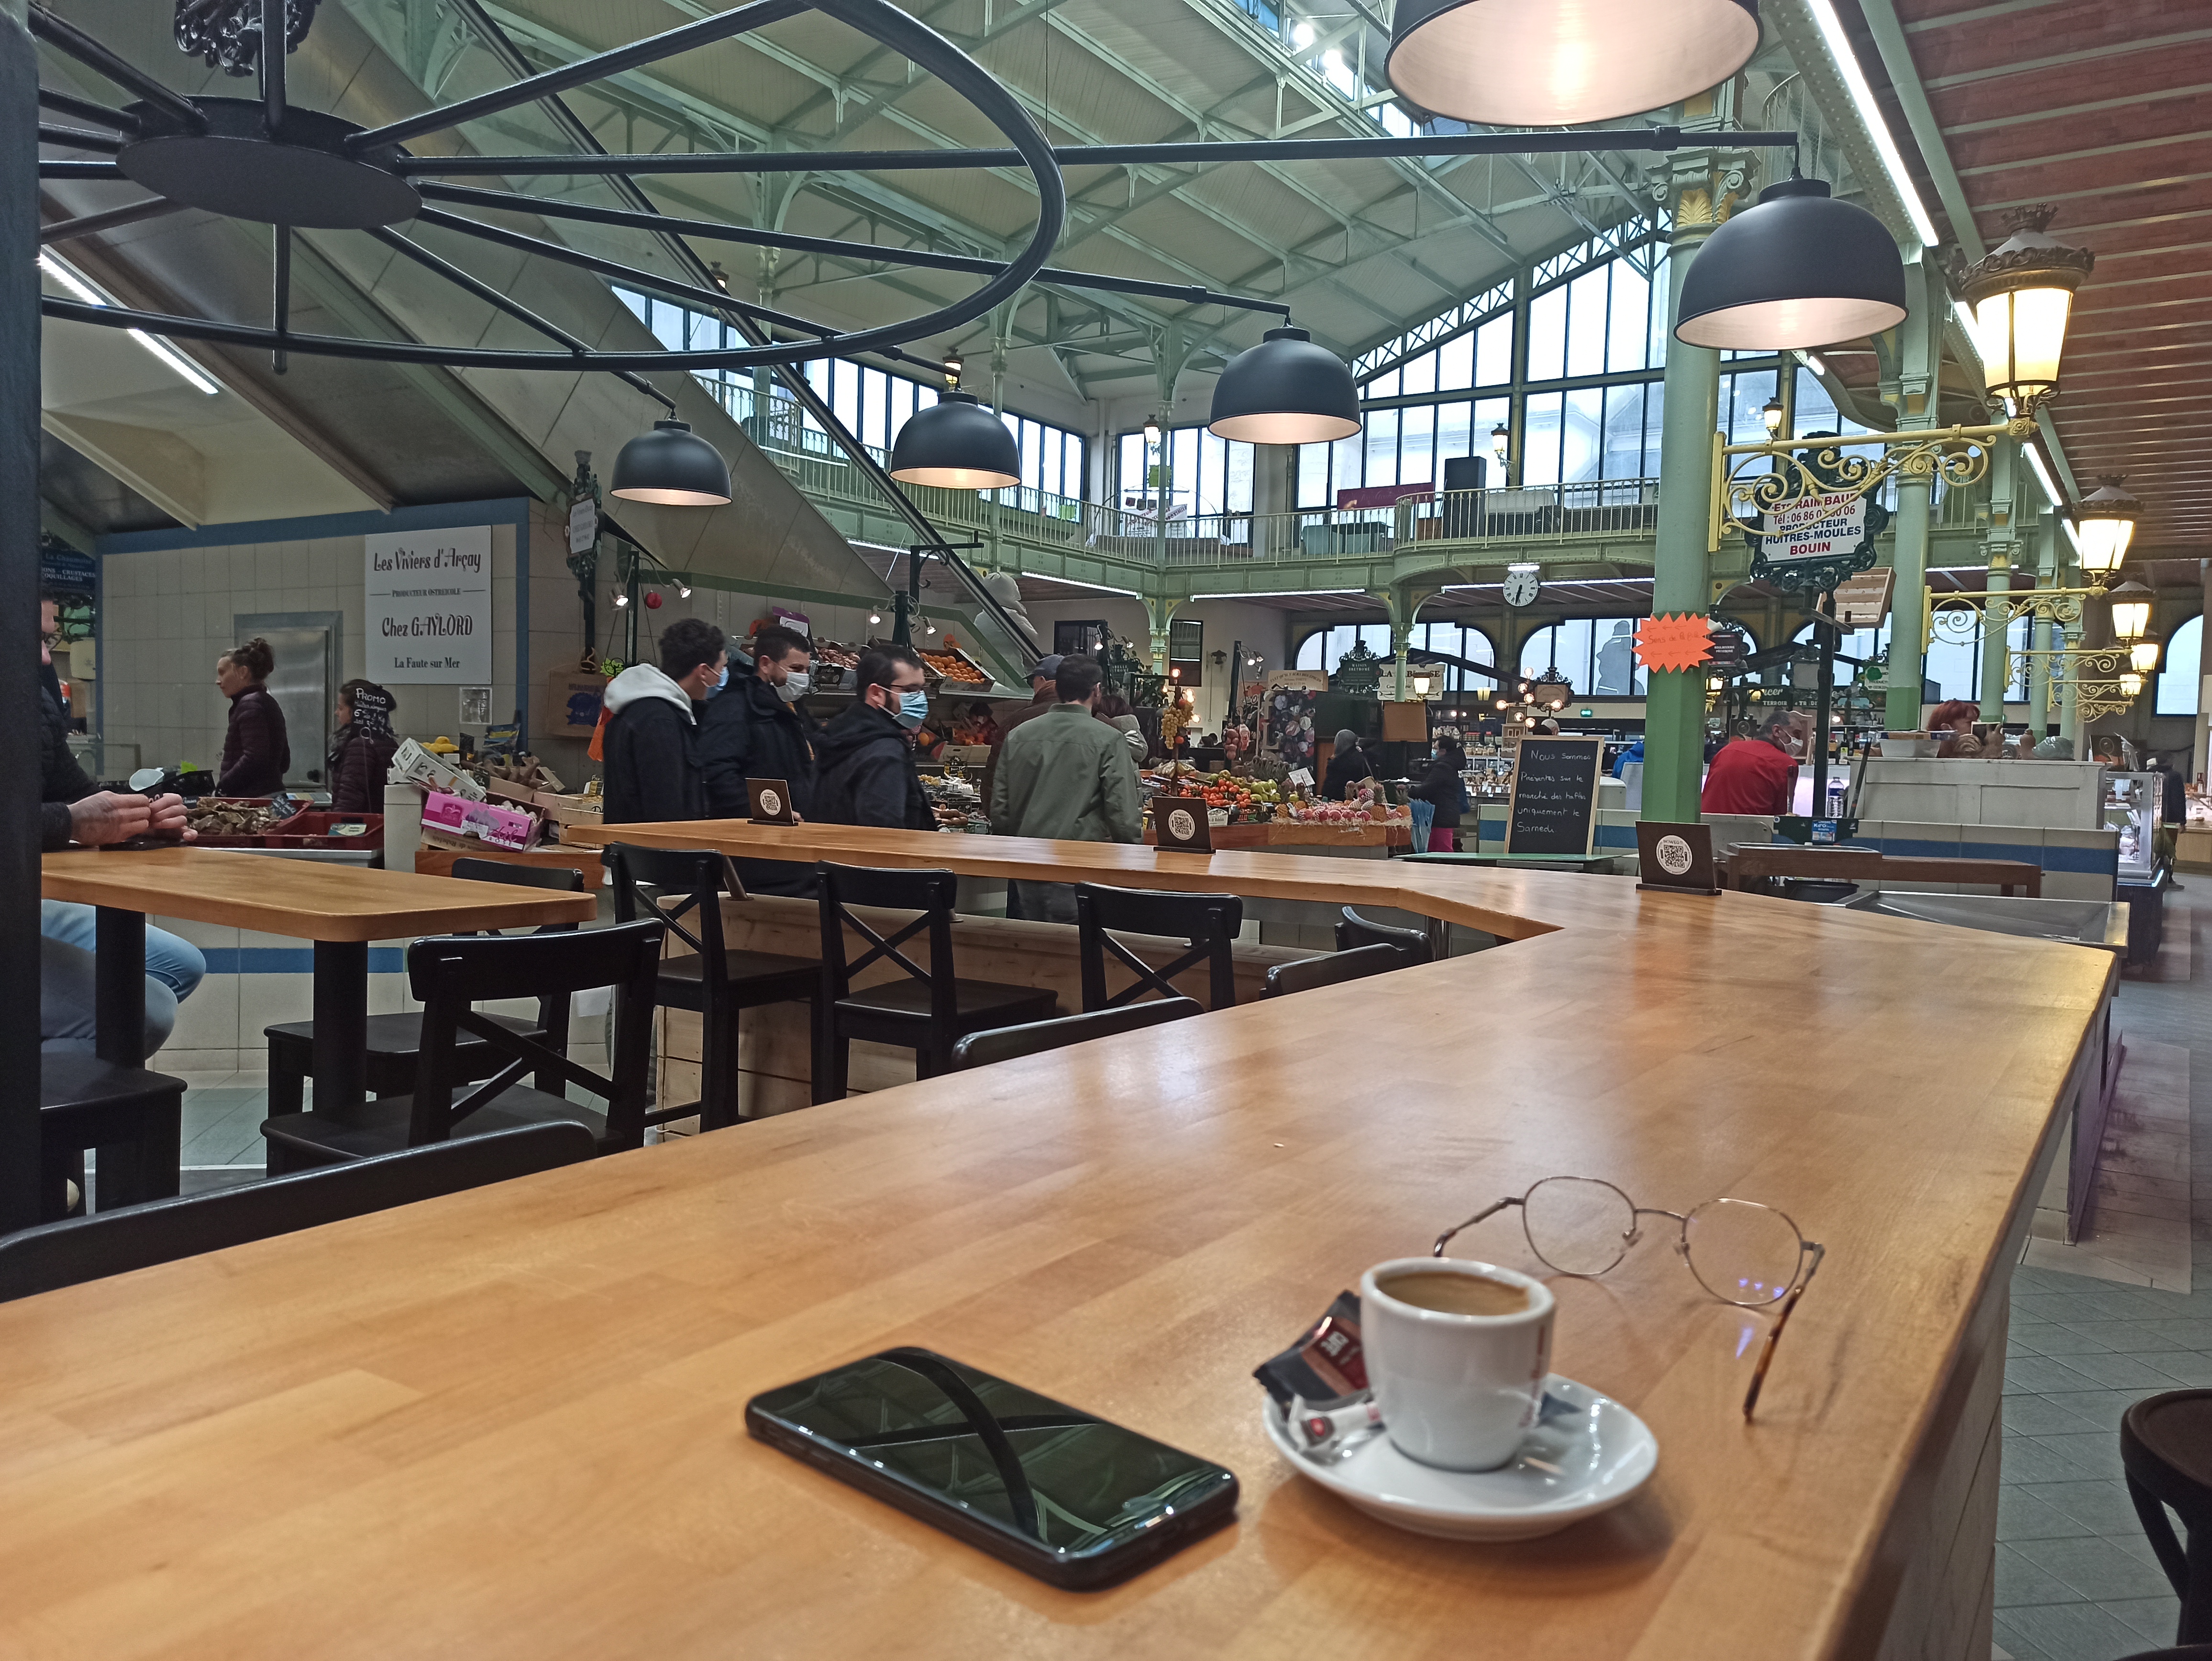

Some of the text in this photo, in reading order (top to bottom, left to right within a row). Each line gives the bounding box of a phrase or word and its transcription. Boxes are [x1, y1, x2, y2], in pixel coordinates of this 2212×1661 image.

[1791, 512, 1801, 522] 06
[1803, 510, 1814, 520] 86
[1844, 505, 1855, 515] 06
[1790, 542, 1831, 555] BOUIN
[374, 553, 393, 571] Les
[395, 547, 431, 570] Viviers
[382, 617, 409, 637] Chez
[1647, 634, 1666, 644] Sens
[394, 657, 460, 668] La Faute sur Mer
[1530, 749, 1556, 761] Nous
[1576, 774, 1583, 782] le
[1518, 790, 1548, 800] marché
[1550, 792, 1562, 800] des
[1517, 807, 1581, 817] uniquement le
